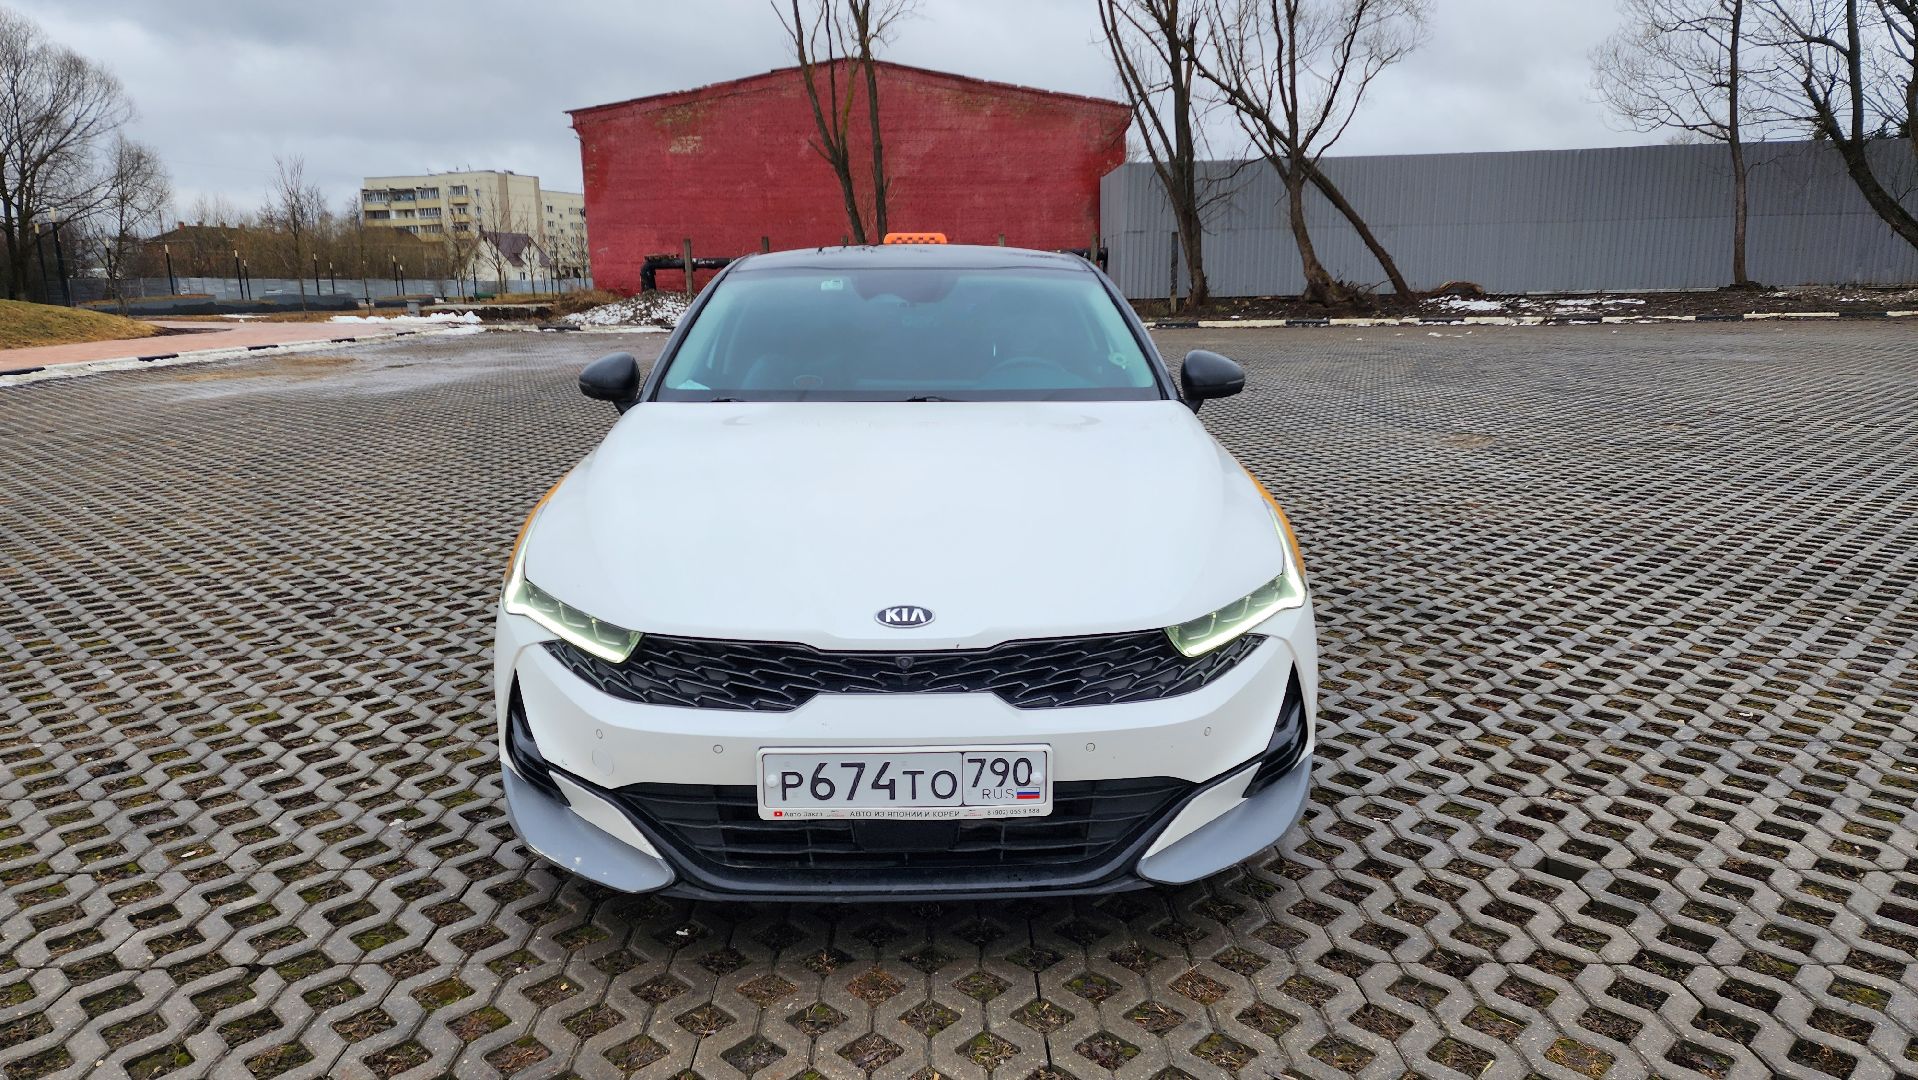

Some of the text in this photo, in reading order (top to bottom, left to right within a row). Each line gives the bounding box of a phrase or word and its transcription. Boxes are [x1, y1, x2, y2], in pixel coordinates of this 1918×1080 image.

[885, 607, 926, 622] KIA
[967, 757, 1033, 788] 790
[982, 788, 1014, 800] RUS
